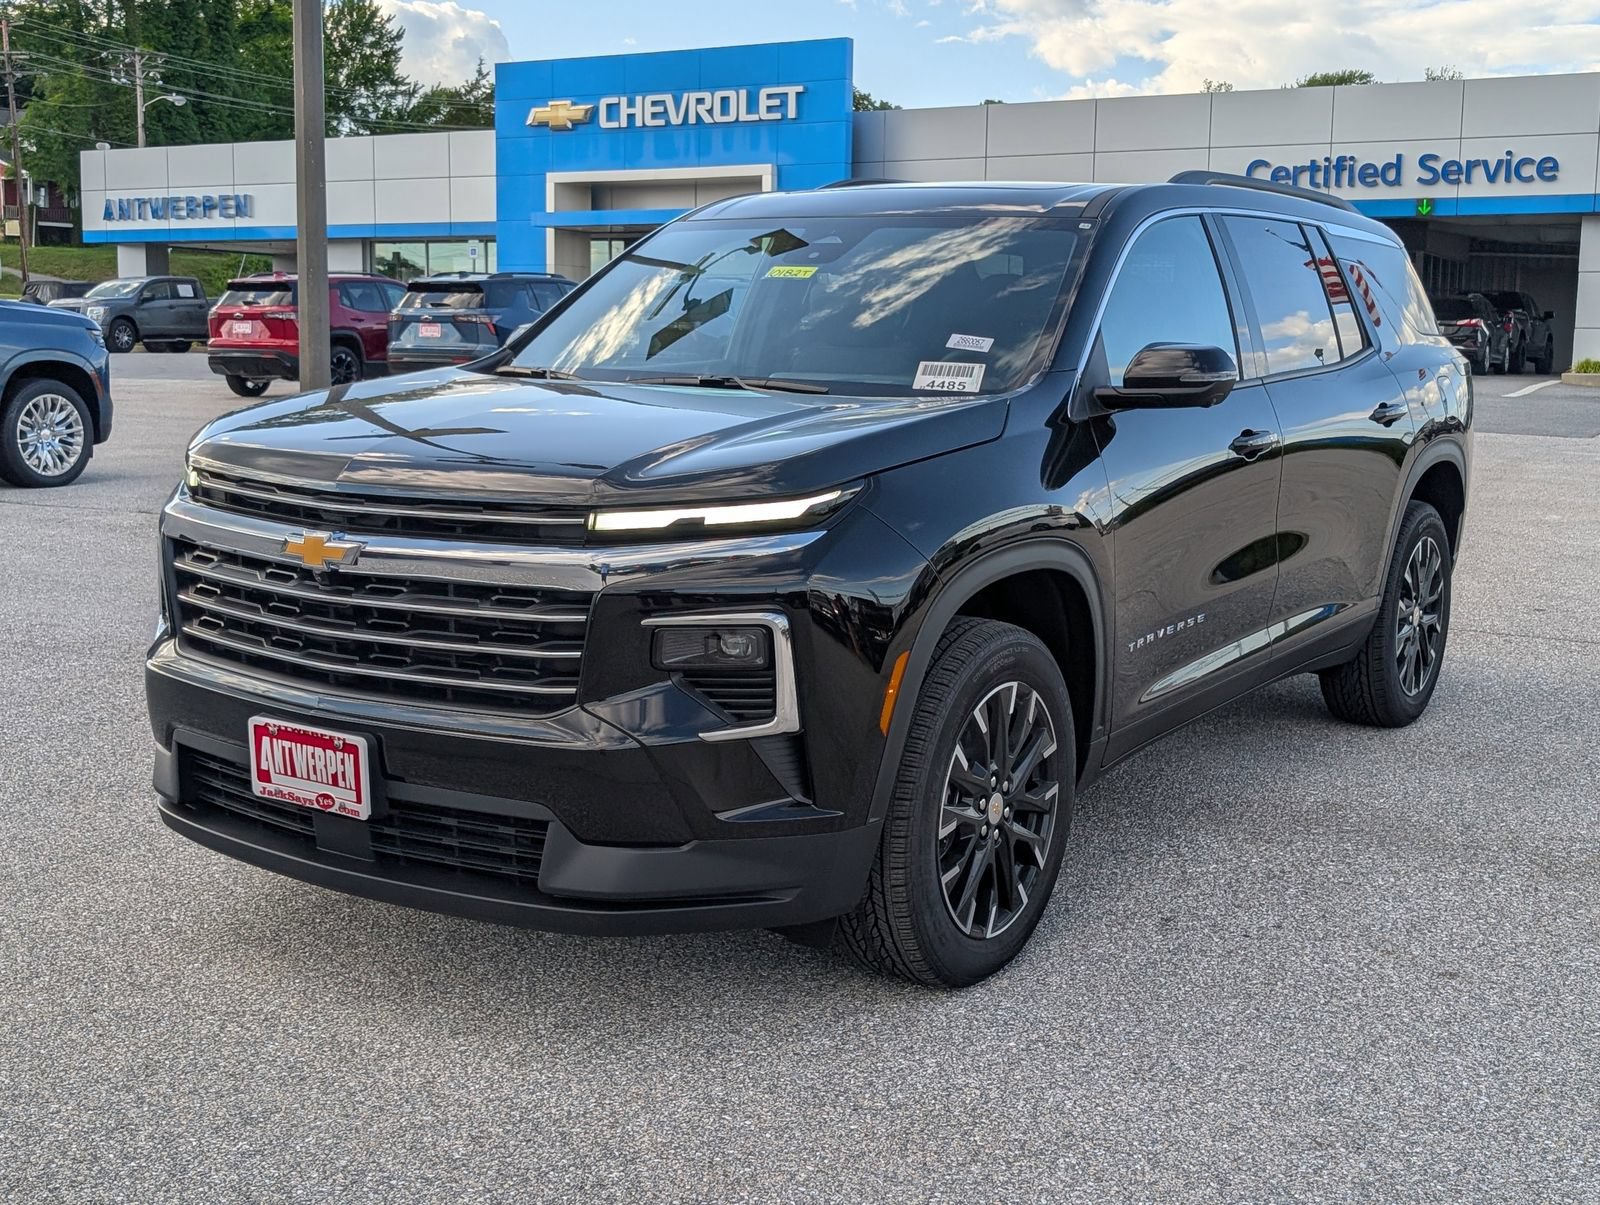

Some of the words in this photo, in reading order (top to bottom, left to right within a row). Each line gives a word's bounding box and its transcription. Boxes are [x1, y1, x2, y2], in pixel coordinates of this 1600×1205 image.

[599, 85, 804, 129] CHEVROLET
[1246, 153, 1403, 188] Certified
[1416, 150, 1559, 186] Service
[103, 194, 254, 221] ANTWERPEN
[926, 380, 967, 391] 4485
[1128, 613, 1206, 653] TRAVERSE
[260, 735, 356, 791] ANTWERPEN
[318, 796, 333, 806] Yes
